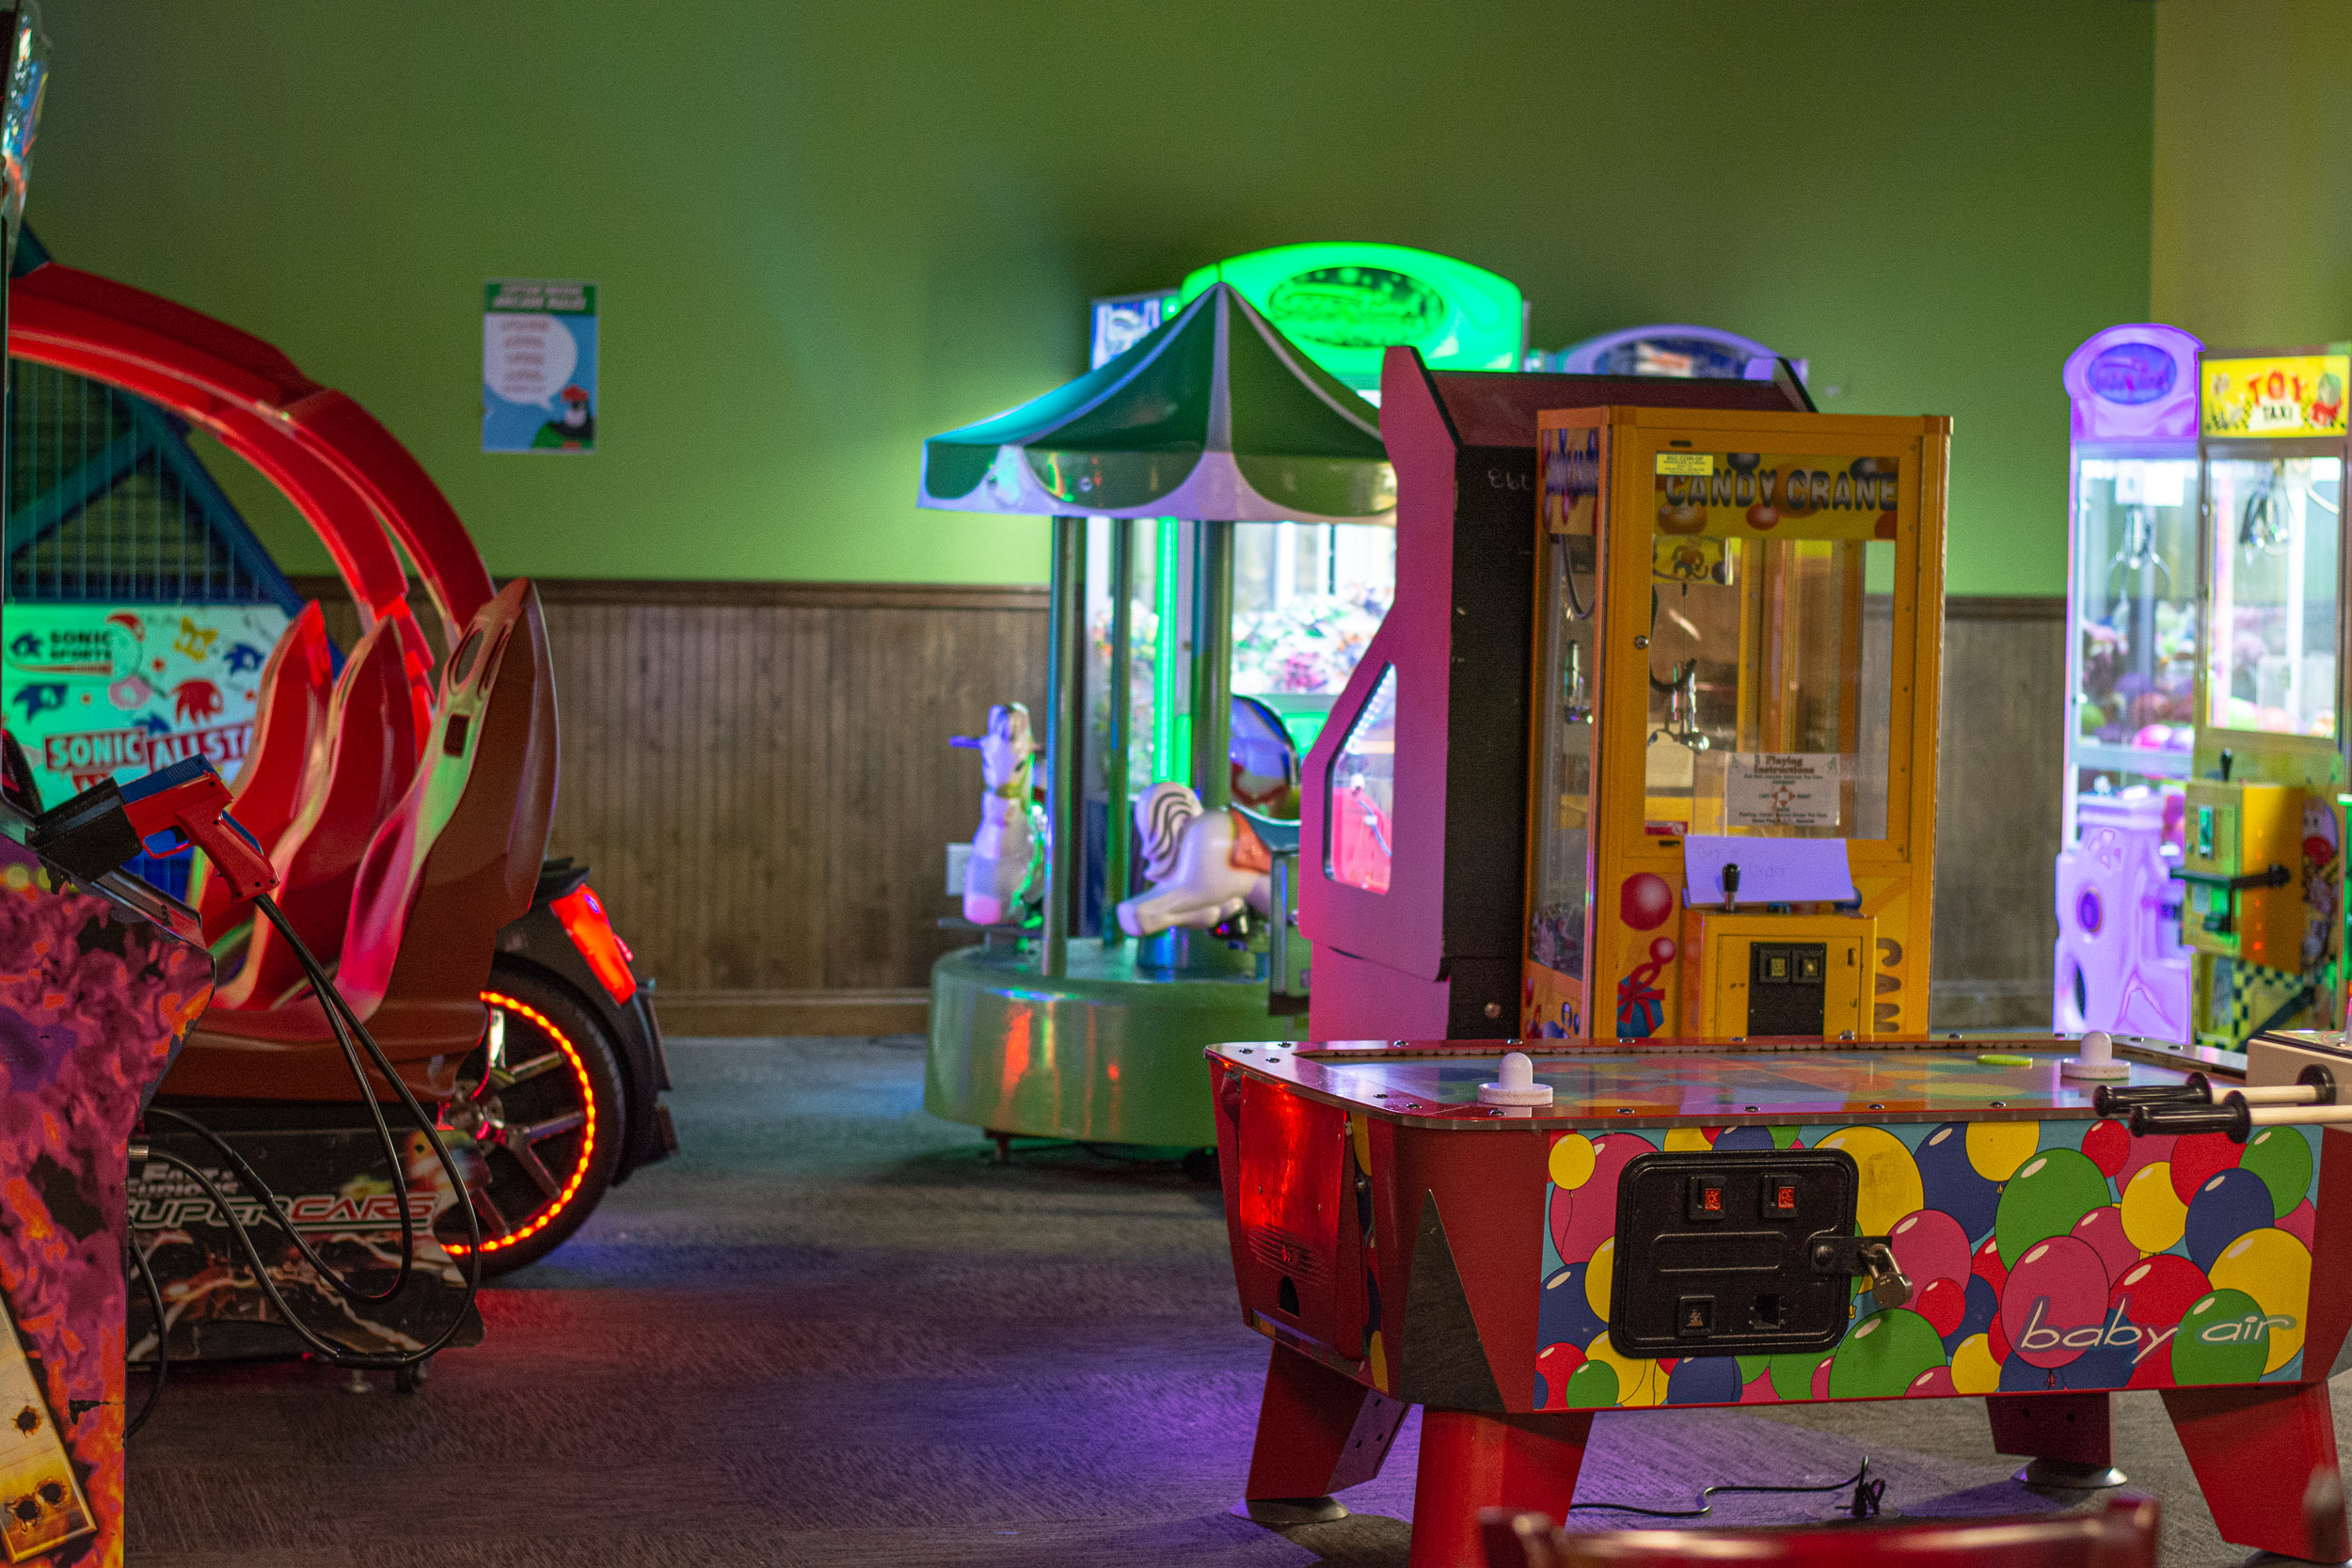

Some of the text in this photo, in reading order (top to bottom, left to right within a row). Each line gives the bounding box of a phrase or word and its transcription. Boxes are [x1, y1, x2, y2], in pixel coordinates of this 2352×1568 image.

[2263, 405, 2293, 420] TAXI
[1665, 469, 1898, 511] CANDY CRANE
[50, 631, 112, 644] SONIC
[50, 733, 142, 769] SONIC
[2020, 1296, 2290, 1364] baby air
